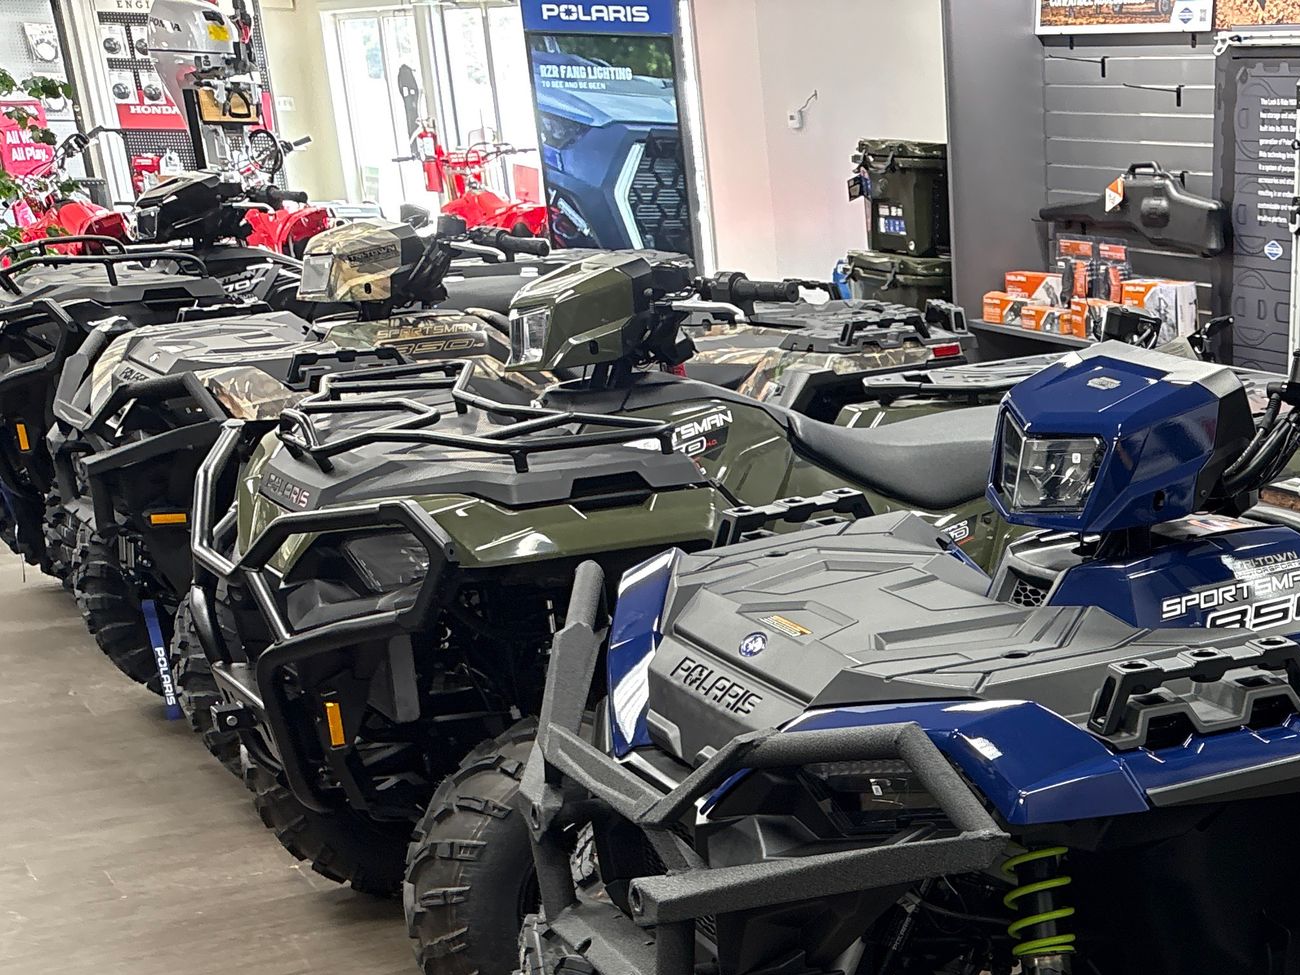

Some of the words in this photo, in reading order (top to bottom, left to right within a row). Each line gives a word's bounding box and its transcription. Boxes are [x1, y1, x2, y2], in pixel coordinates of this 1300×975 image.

[542, 4, 650, 23] POLARIS
[540, 65, 559, 78] RZR
[560, 66, 586, 79] FANG
[587, 66, 632, 80] LIGHTING
[129, 105, 180, 114] HONDA
[6, 131, 20, 144] All
[12, 147, 26, 161] All
[26, 146, 48, 161] Play.
[377, 323, 477, 339] SPORTSMAN
[673, 410, 734, 442] TSMAN
[268, 473, 310, 508] POLARIS
[1238, 551, 1298, 570] RI-TOWN
[155, 647, 176, 706] POLARIS
[670, 656, 763, 715] POLARIS
